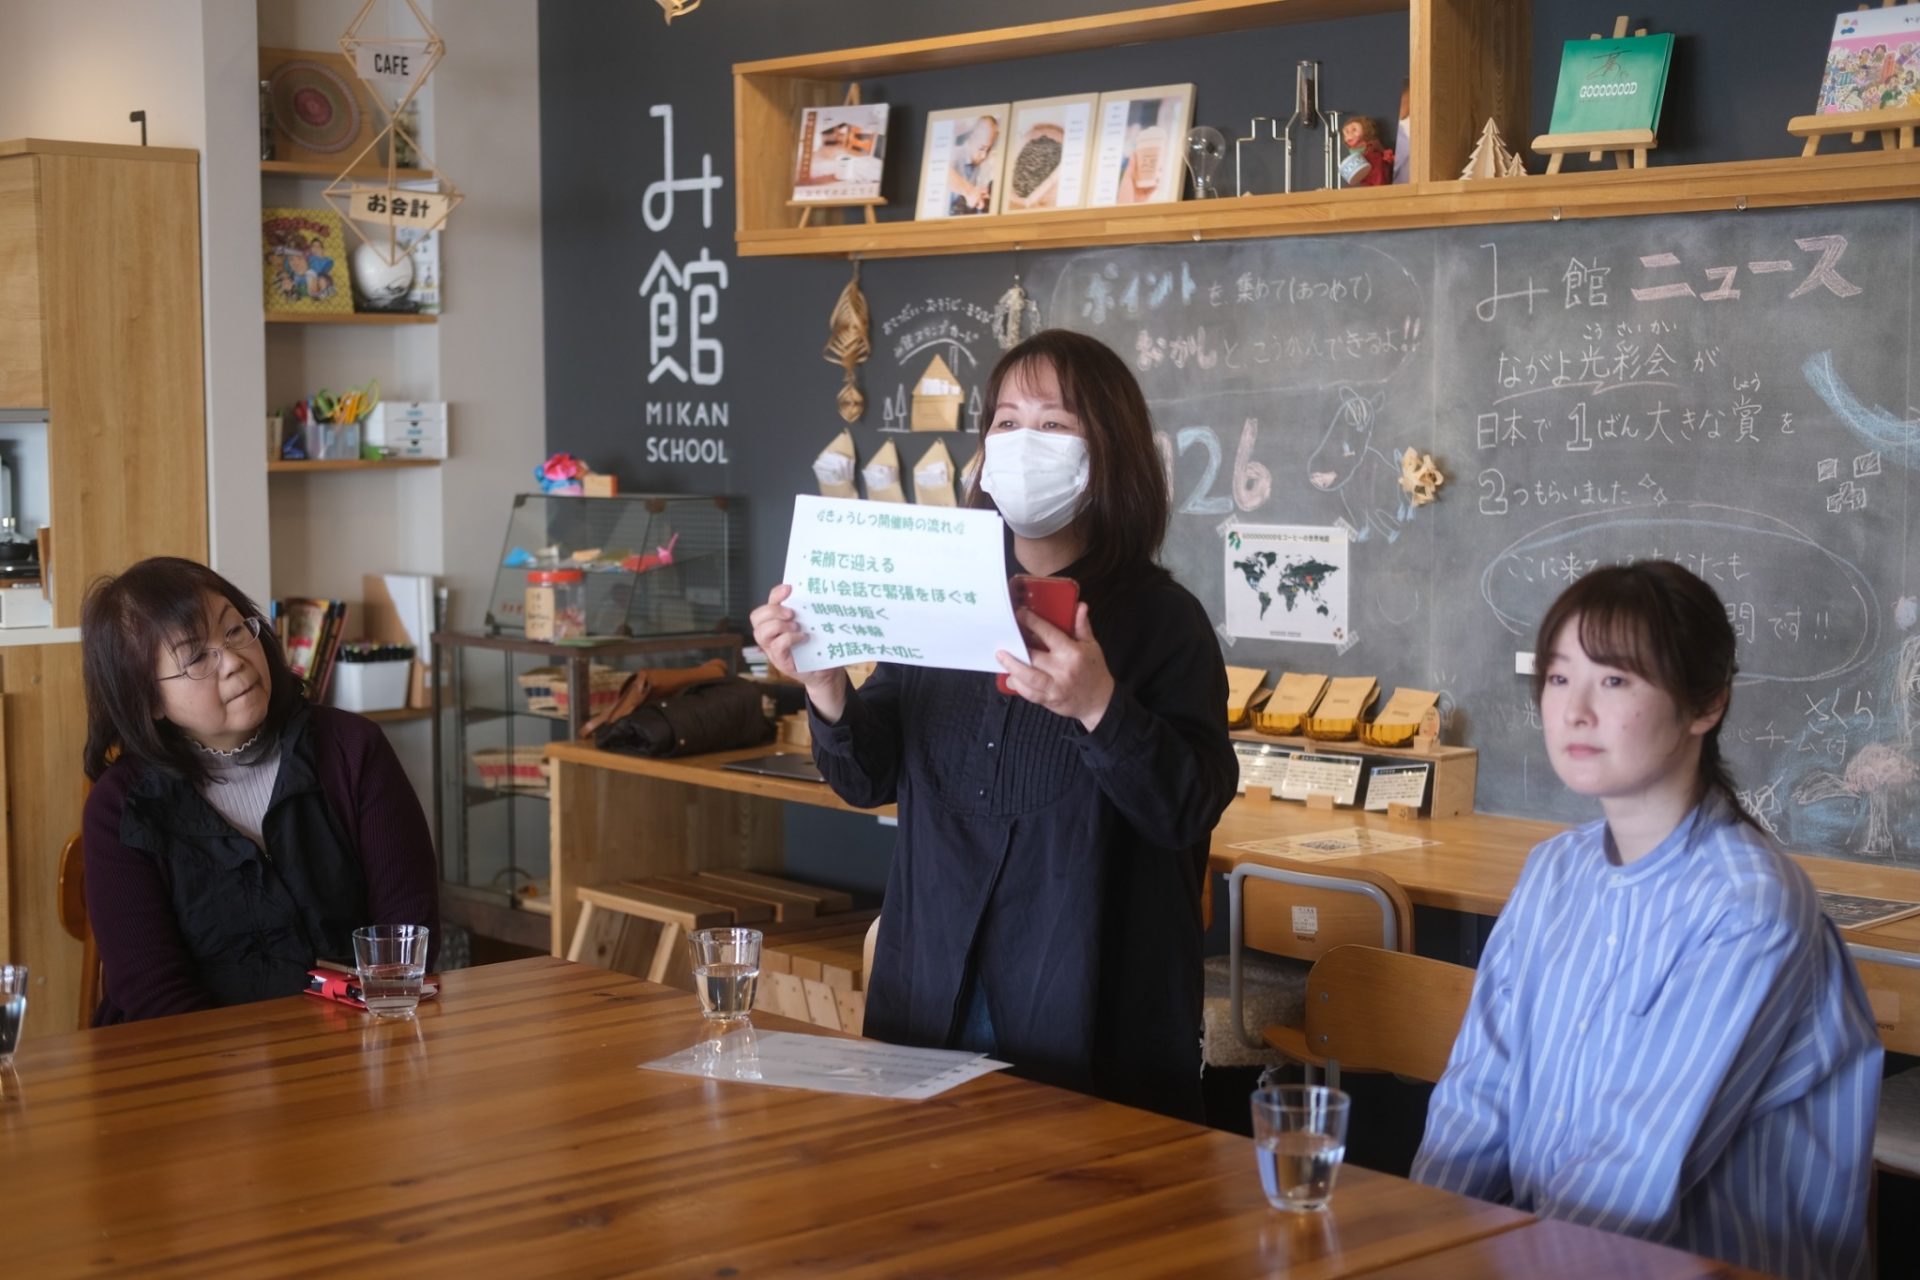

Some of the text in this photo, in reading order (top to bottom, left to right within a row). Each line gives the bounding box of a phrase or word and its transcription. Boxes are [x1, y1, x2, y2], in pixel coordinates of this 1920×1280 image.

[374, 53, 410, 76] CAFE
[367, 194, 430, 218] お会計
[646, 402, 729, 427] MIKAN
[646, 436, 729, 464] SCHOOL
[809, 549, 895, 574] 笑顔で迎える
[807, 577, 978, 606] 軽い会話で緊張をほぐす
[810, 602, 890, 621] 説明は短く
[820, 621, 886, 639] すぐ体験
[826, 641, 925, 660] 対話を大切に
